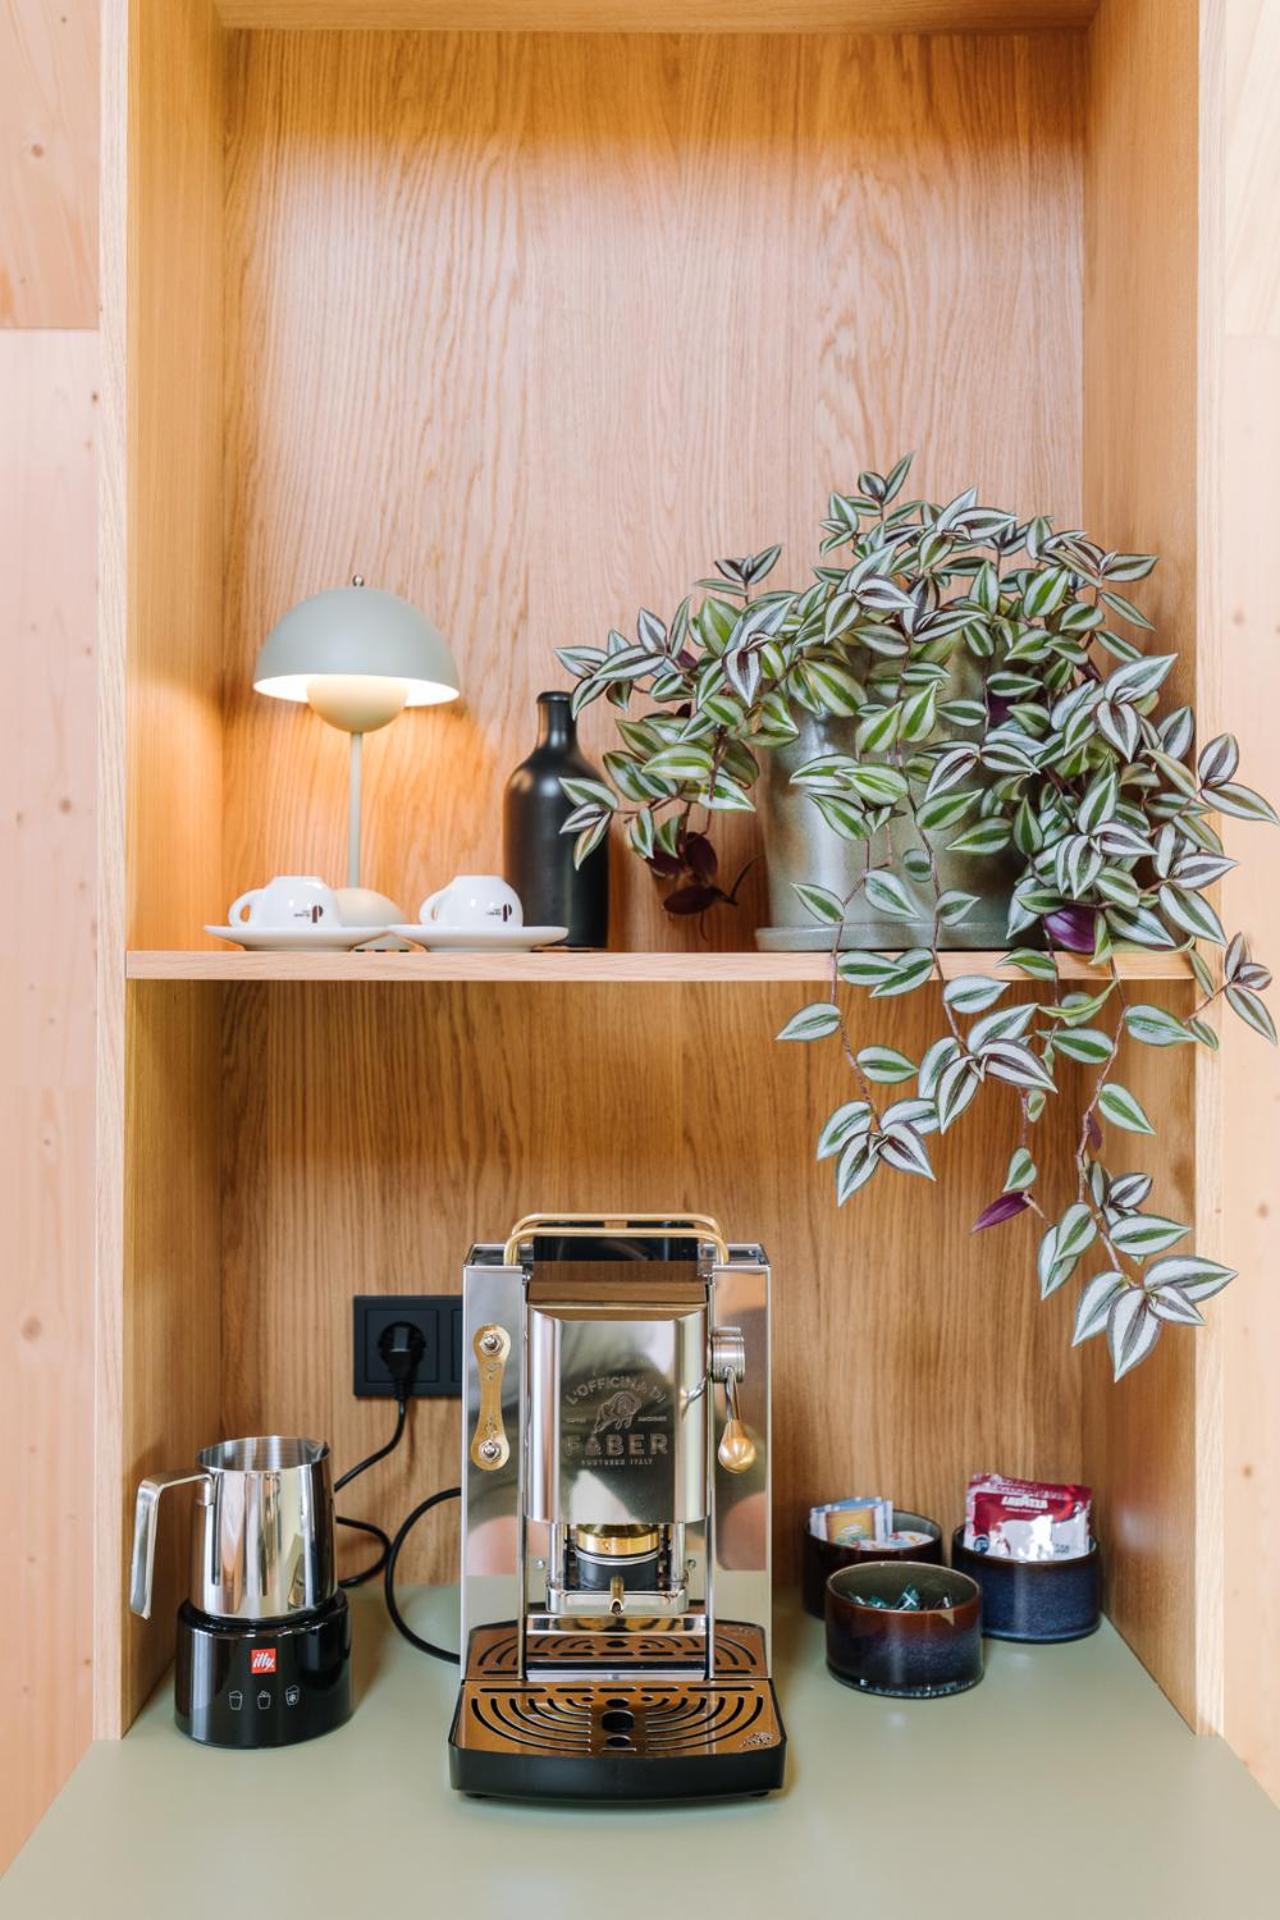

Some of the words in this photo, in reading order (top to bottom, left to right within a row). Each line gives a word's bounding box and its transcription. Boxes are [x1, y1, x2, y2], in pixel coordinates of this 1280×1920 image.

[565, 1375, 648, 1405] L'OFFICINA
[650, 1385, 667, 1404] DI
[565, 1433, 668, 1456] FABER
[629, 1458, 654, 1466] ITALY
[252, 1652, 275, 1670] illy
